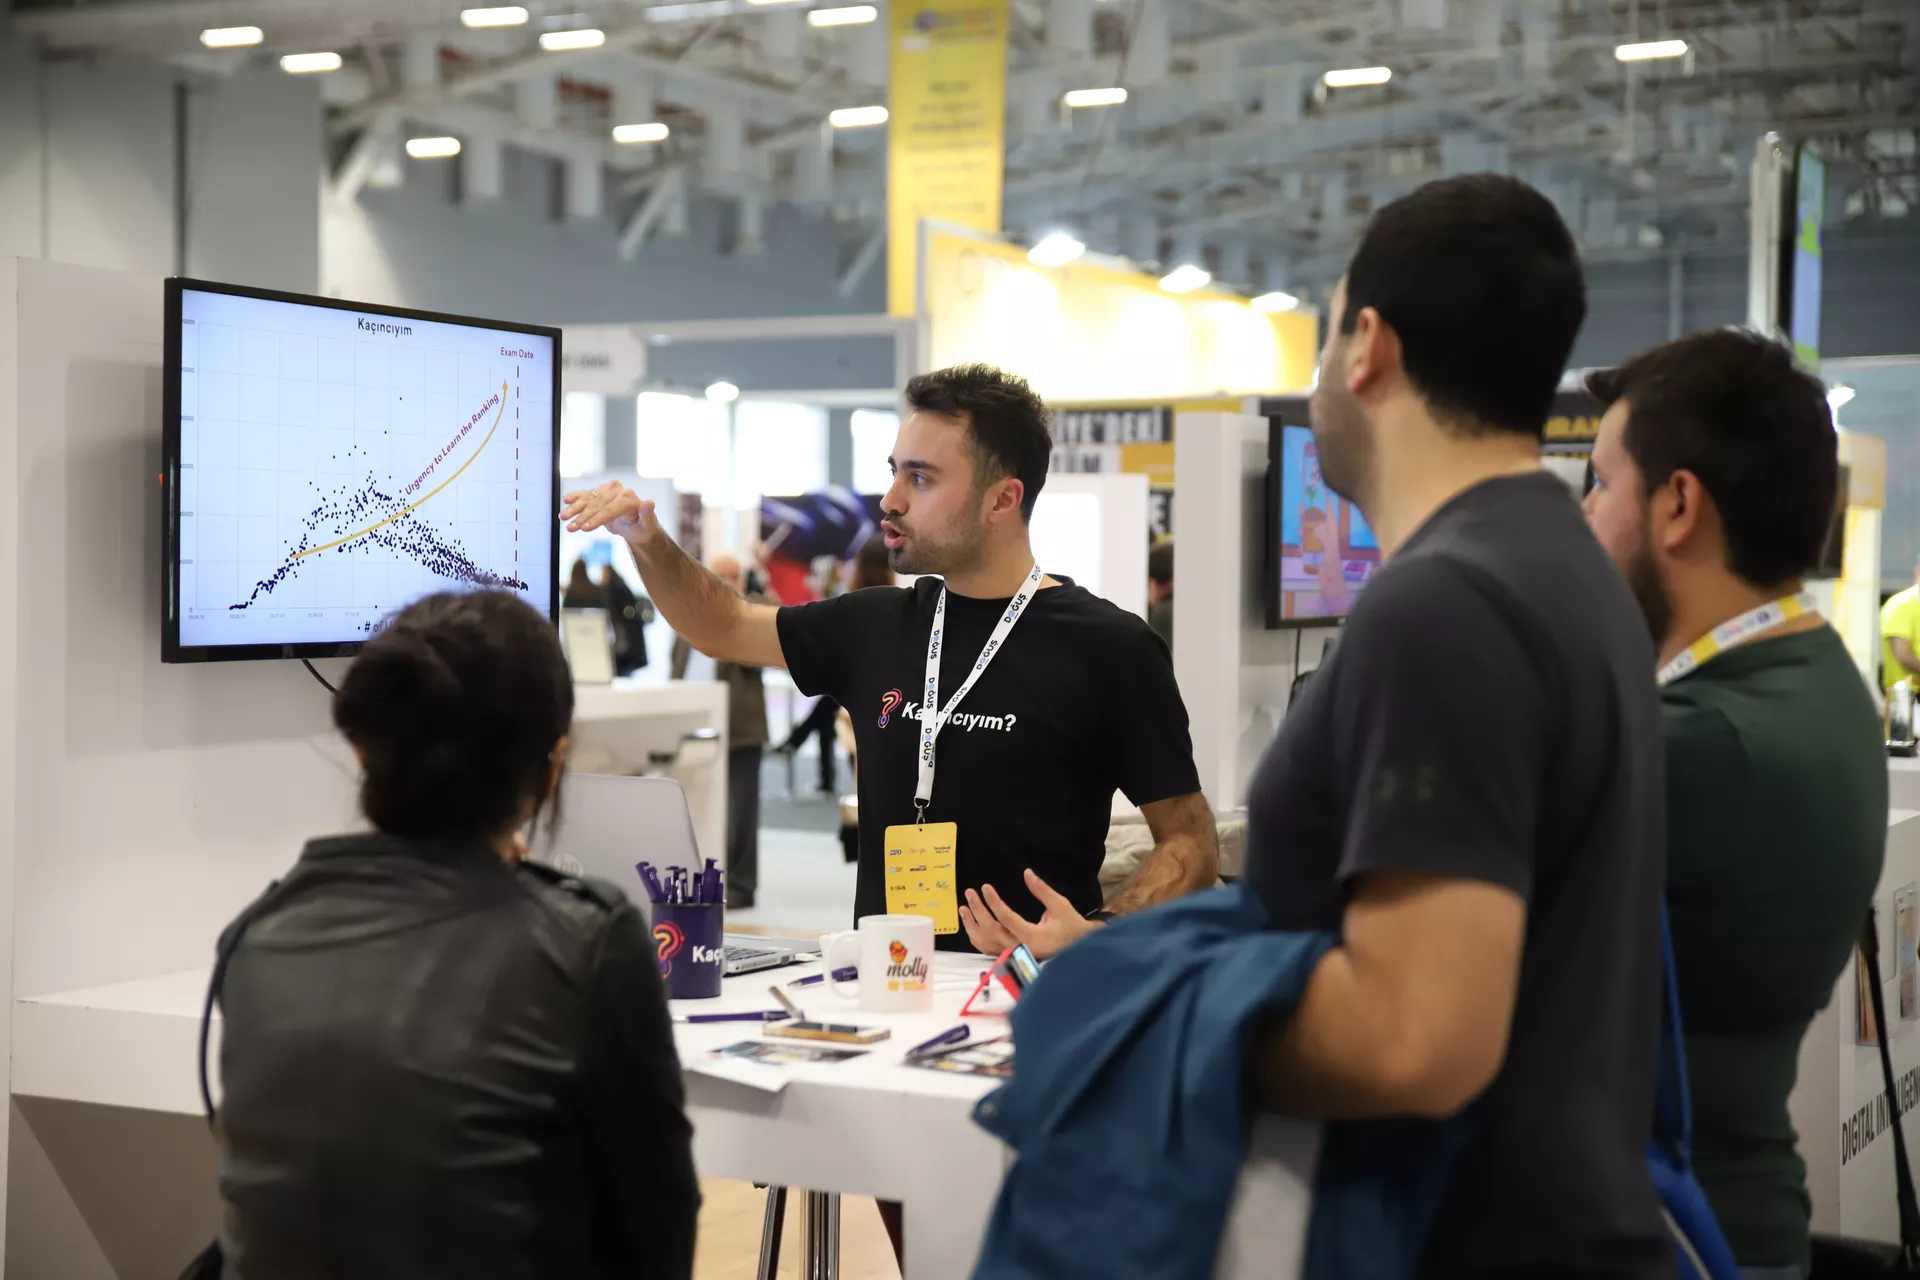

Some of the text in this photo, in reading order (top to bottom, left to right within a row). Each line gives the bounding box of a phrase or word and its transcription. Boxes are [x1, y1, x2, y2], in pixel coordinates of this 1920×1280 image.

[358, 317, 412, 338] Kaçıncıyım
[500, 346, 534, 360] Exam Date
[404, 393, 500, 496] Urgency to Learn the Ranking
[901, 701, 1017, 732] Kacıyım?
[886, 956, 928, 984] molly
[1842, 1100, 1875, 1167] DIGITAL
